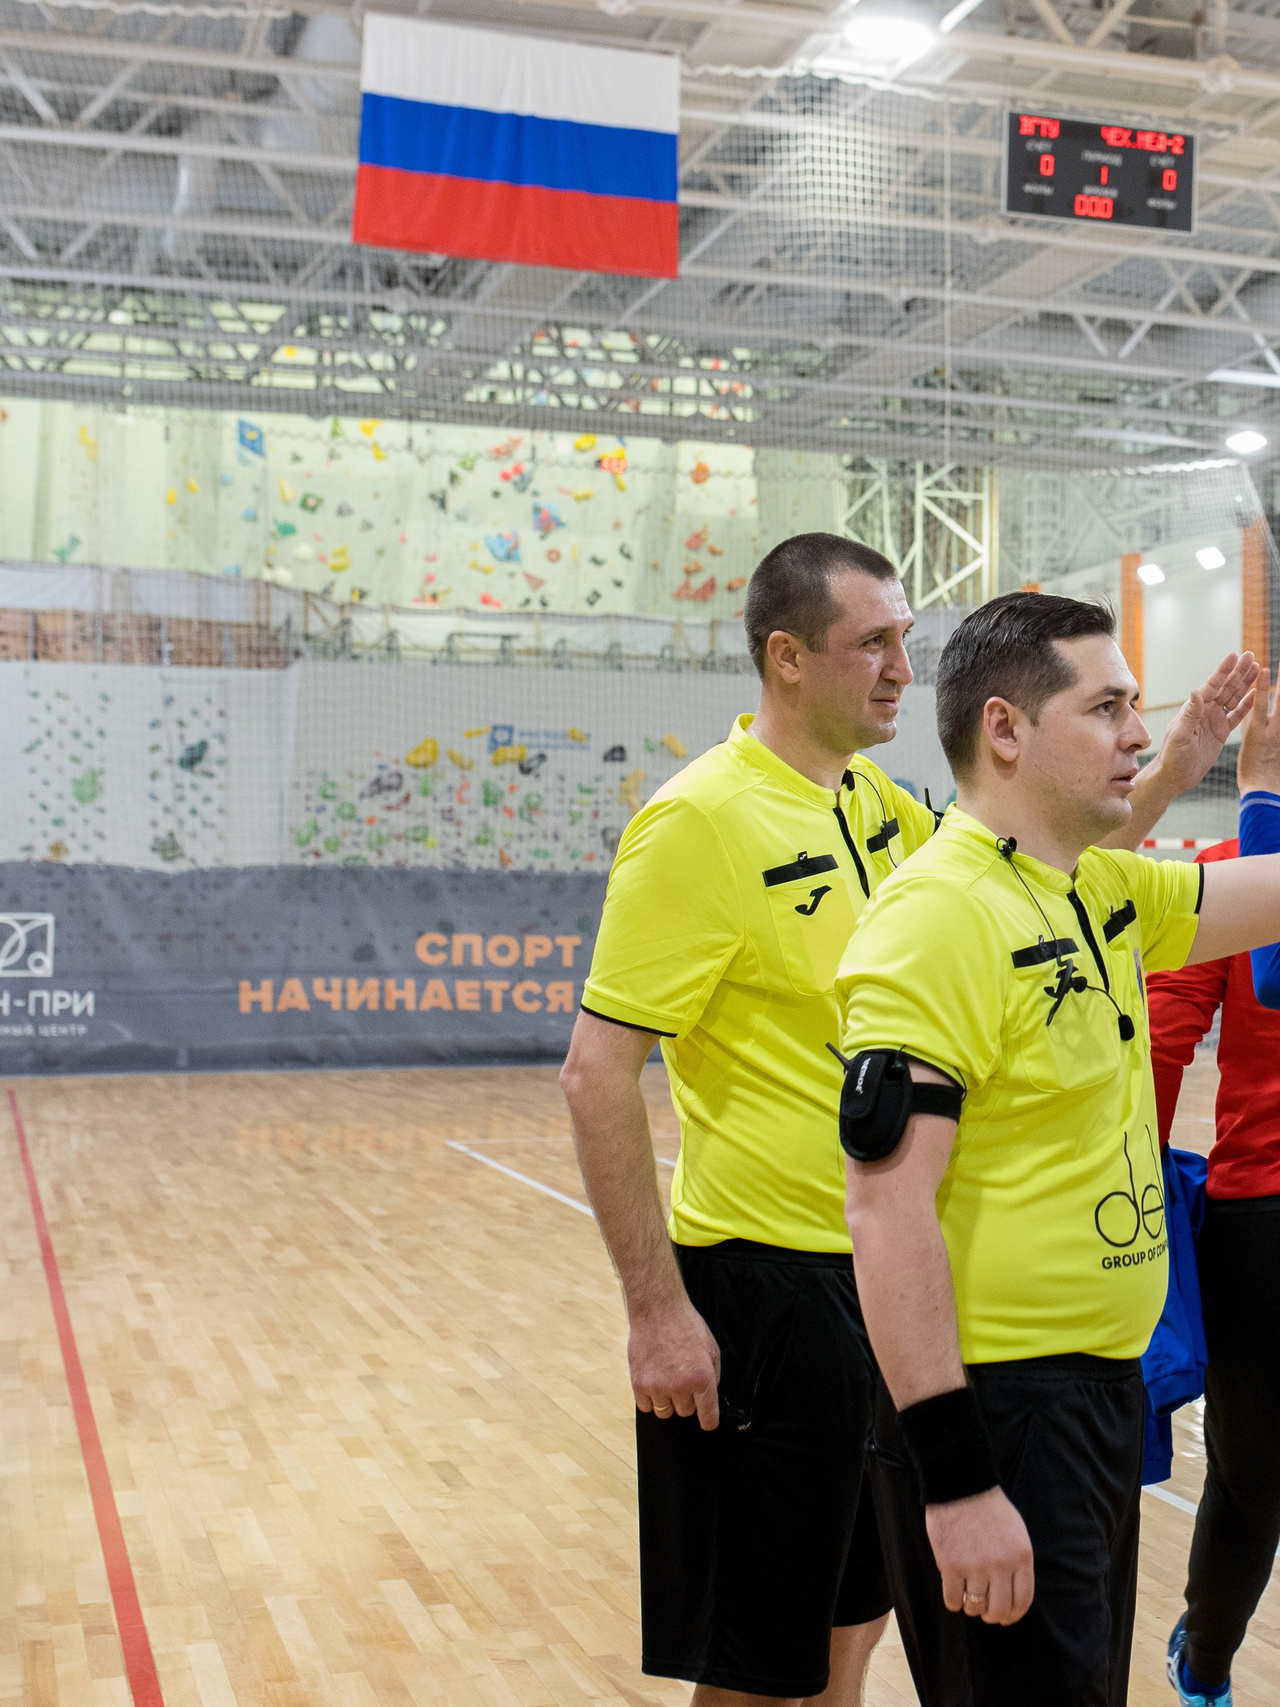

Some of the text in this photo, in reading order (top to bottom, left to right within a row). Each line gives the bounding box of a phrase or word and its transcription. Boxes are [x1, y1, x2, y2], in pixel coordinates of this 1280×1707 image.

[1039, 154, 1055, 176] 0
[1100, 165, 1108, 185] 1
[1162, 169, 1177, 191] 0
[415, 933, 582, 967] СПОРТ
[239, 978, 575, 1014] НАЧИНАЕТСЯ
[1102, 1251, 1146, 1269] GROUP
[1148, 1246, 1156, 1262] OF
